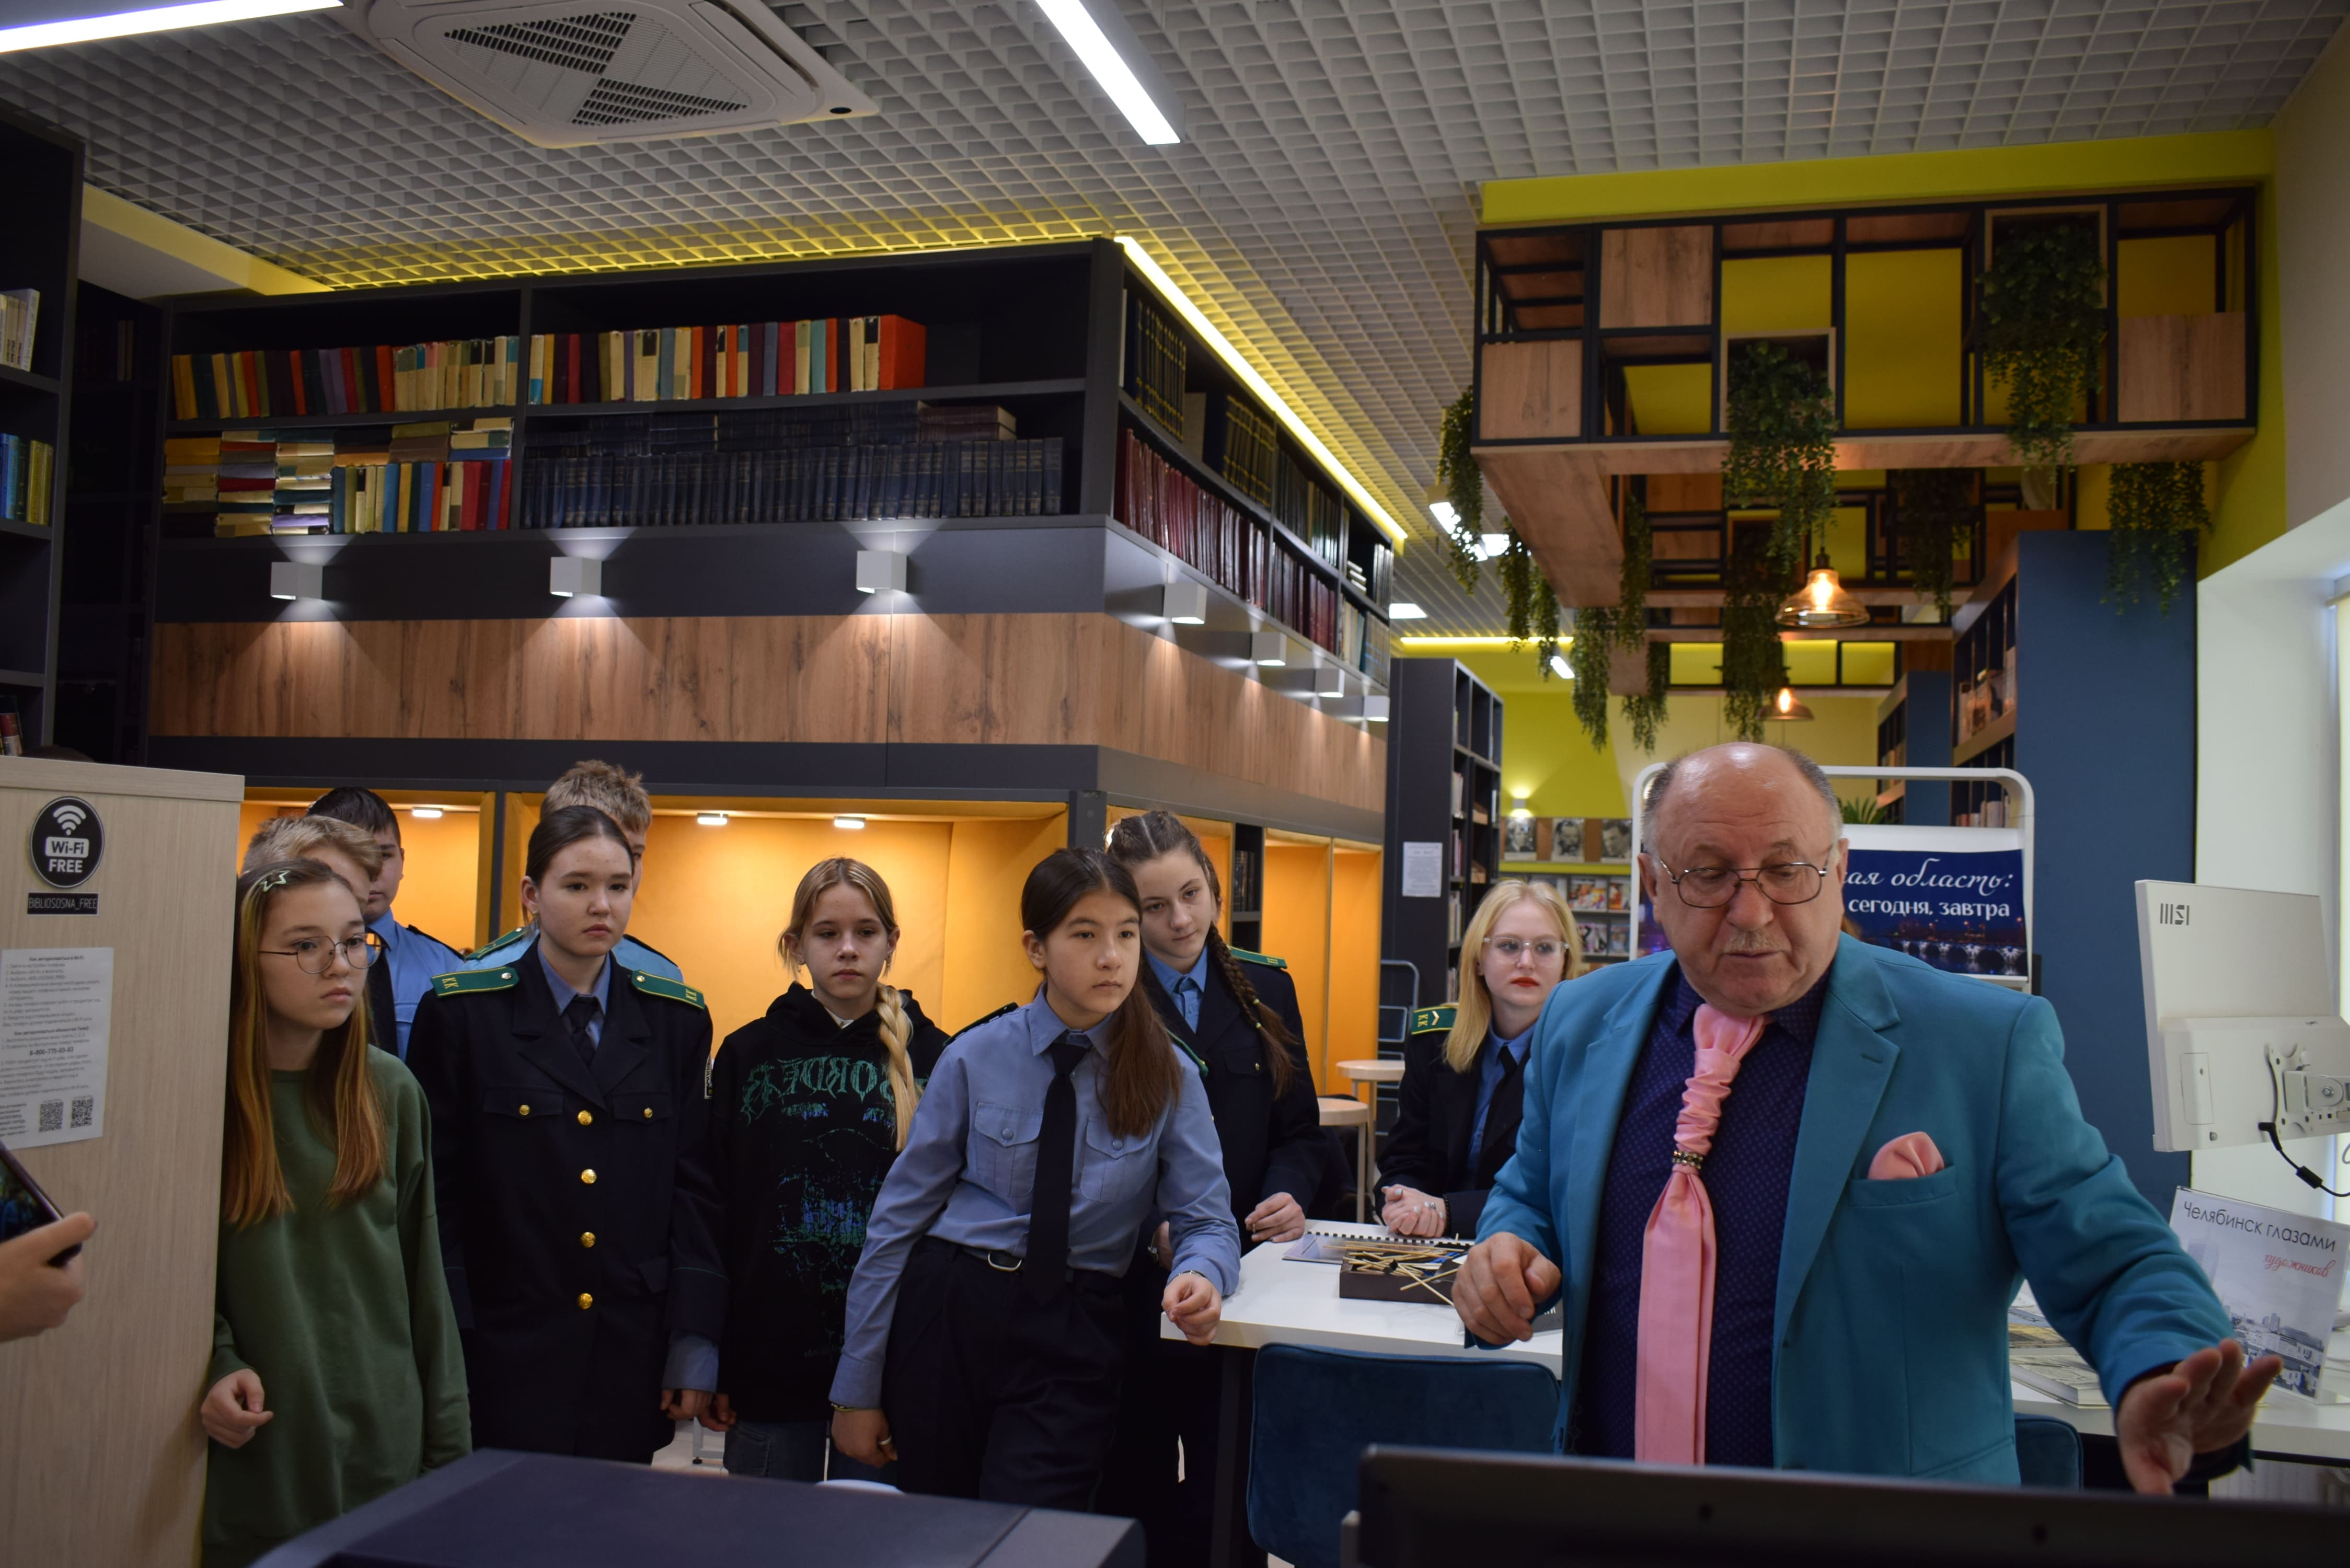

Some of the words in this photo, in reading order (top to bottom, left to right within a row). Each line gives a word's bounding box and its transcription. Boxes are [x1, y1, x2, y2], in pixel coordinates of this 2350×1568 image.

[51, 840, 85, 855] Wi-Fi
[49, 859, 83, 873] FREE
[1890, 858, 2014, 896] область:
[28, 897, 97, 910] BIBLIOSOSNA_FREE
[1848, 898, 1933, 917] сегодня,
[1939, 901, 2010, 921] завтра
[2184, 1201, 2264, 1235] Челябинск
[2266, 1224, 2336, 1252] глазами
[2263, 1254, 2336, 1277] художников
